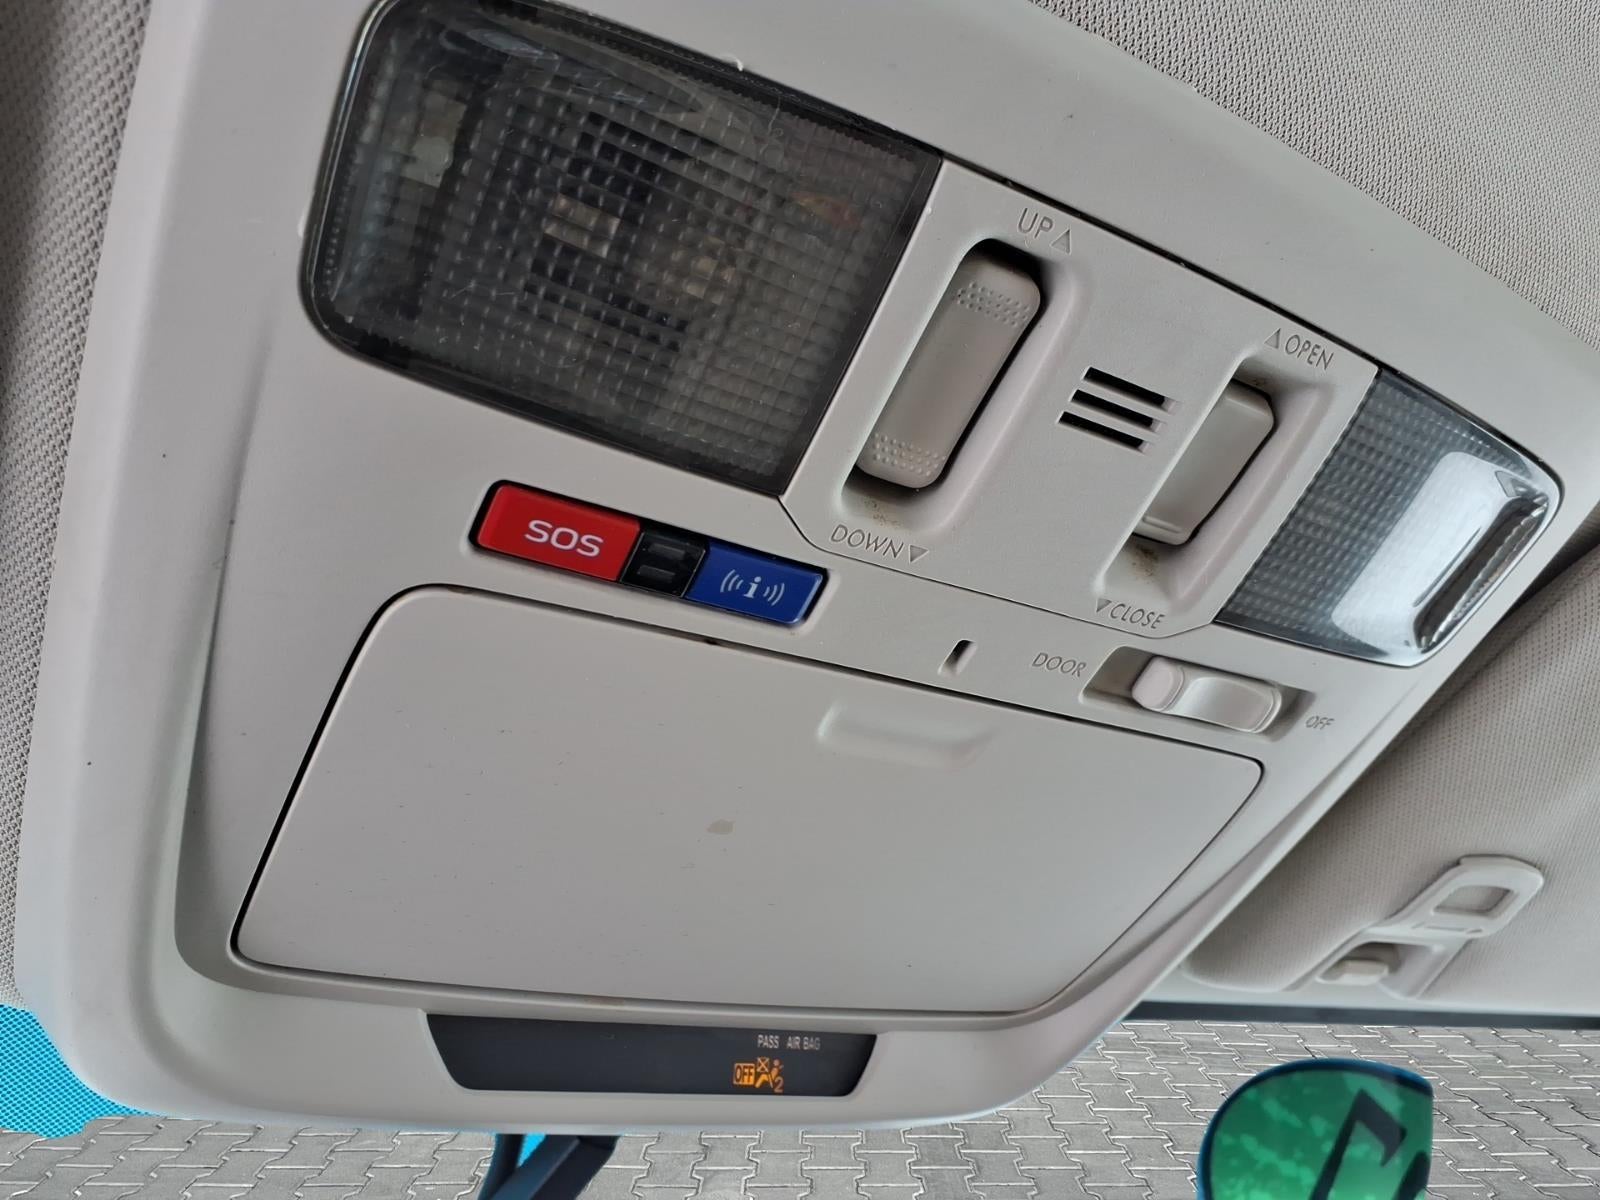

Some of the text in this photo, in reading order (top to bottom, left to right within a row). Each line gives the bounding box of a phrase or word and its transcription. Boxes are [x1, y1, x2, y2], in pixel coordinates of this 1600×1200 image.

[1018, 207, 1054, 239] UP
[1285, 334, 1334, 370] OPEN
[524, 519, 603, 557] SOS
[830, 524, 904, 558] DOWN
[1110, 603, 1165, 629] CLOSE
[1032, 652, 1087, 677] DOOR
[1305, 715, 1335, 730] OFF
[757, 1034, 780, 1049] PASS
[735, 1063, 755, 1085] OFF
[774, 1077, 783, 1093] 2
